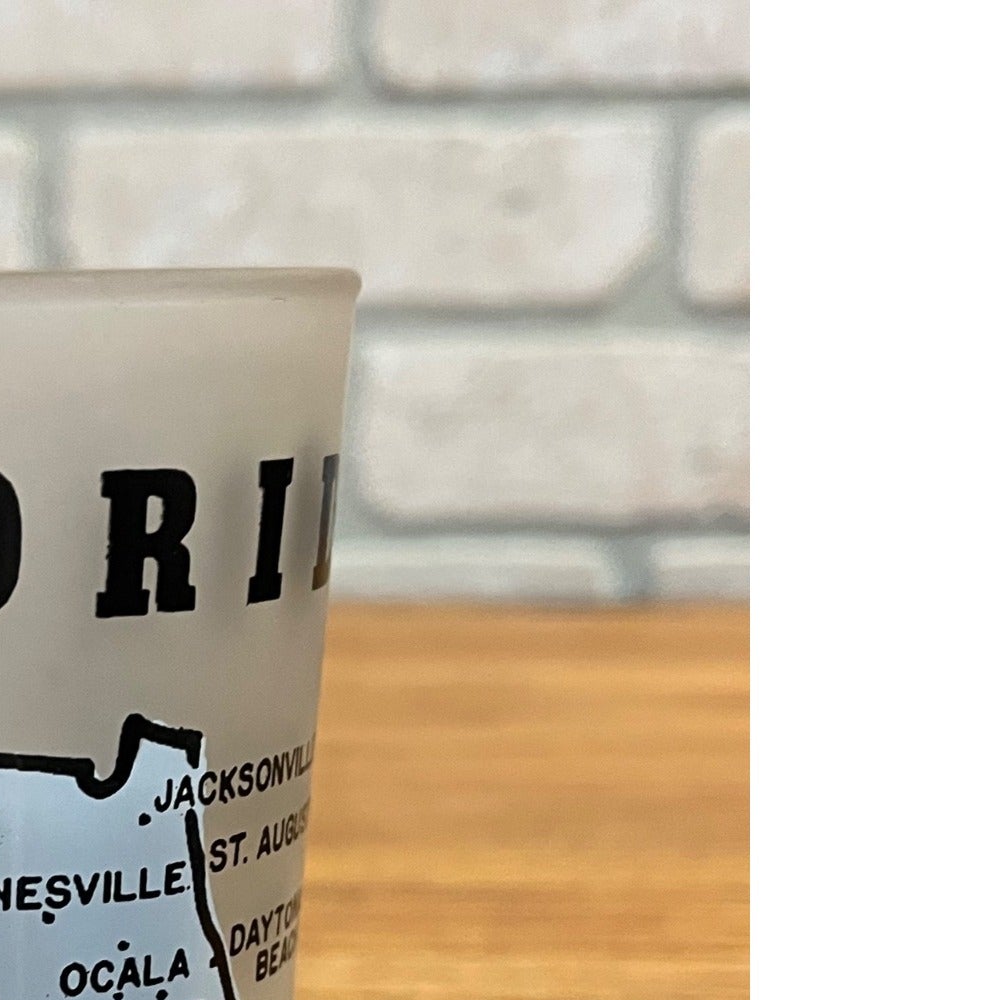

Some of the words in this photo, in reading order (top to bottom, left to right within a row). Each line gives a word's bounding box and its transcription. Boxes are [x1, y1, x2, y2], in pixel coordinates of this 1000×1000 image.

[154, 731, 316, 813] JACKSONVILL
[209, 831, 248, 873] ST.
[59, 948, 190, 998] OCALA
